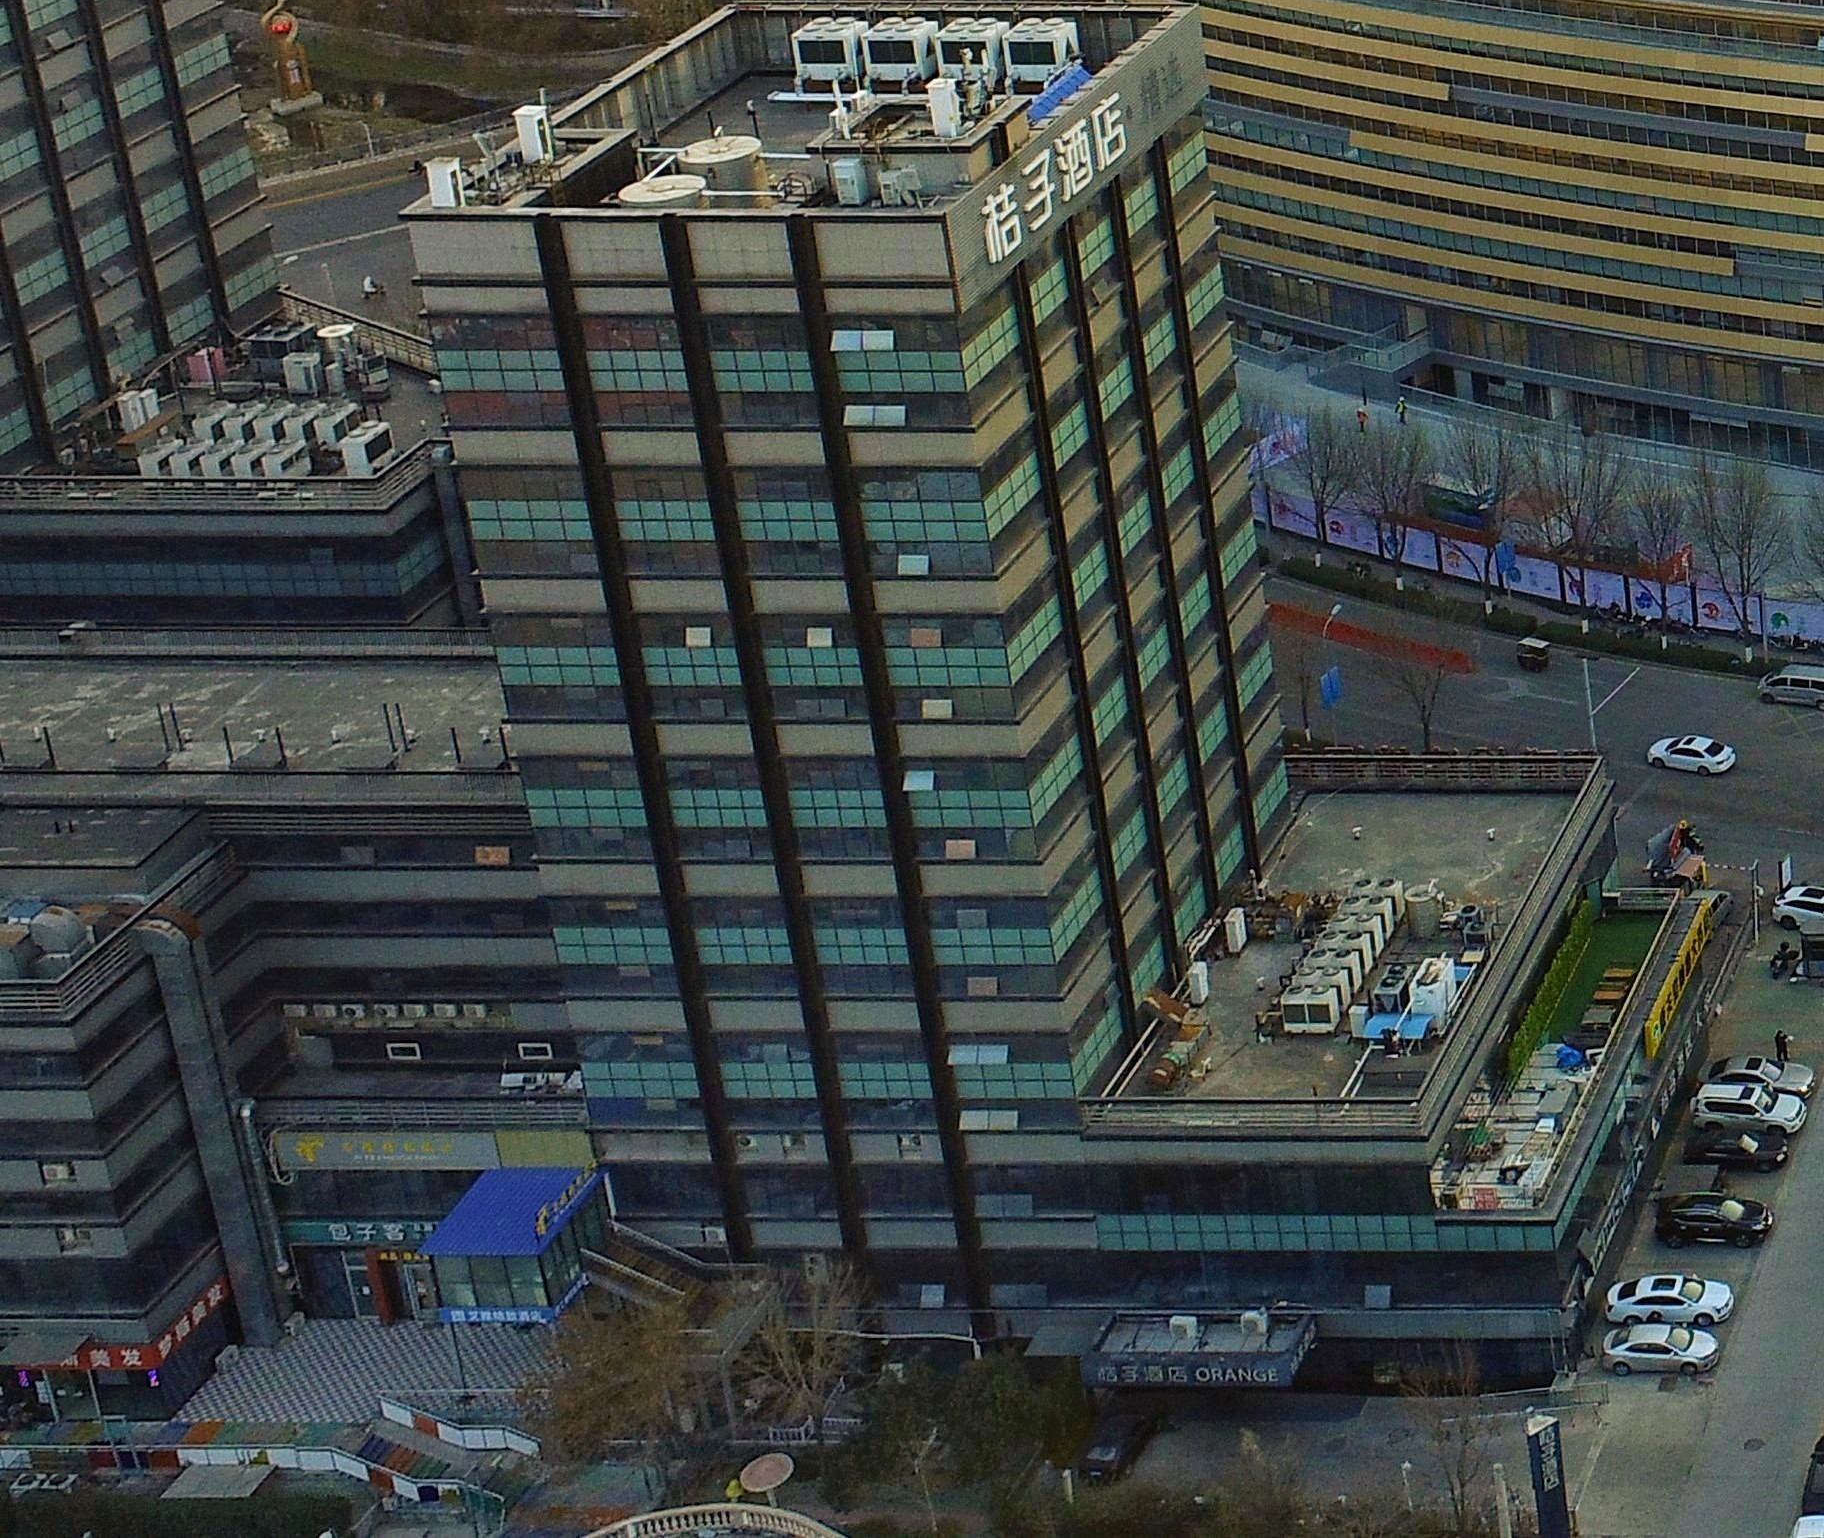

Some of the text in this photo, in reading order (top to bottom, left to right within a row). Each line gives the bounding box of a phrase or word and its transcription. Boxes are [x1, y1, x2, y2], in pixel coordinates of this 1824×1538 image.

[981, 92, 1127, 264] 桔子酒店
[1099, 1365, 1278, 1383] 桔子酒店 ORANGE
